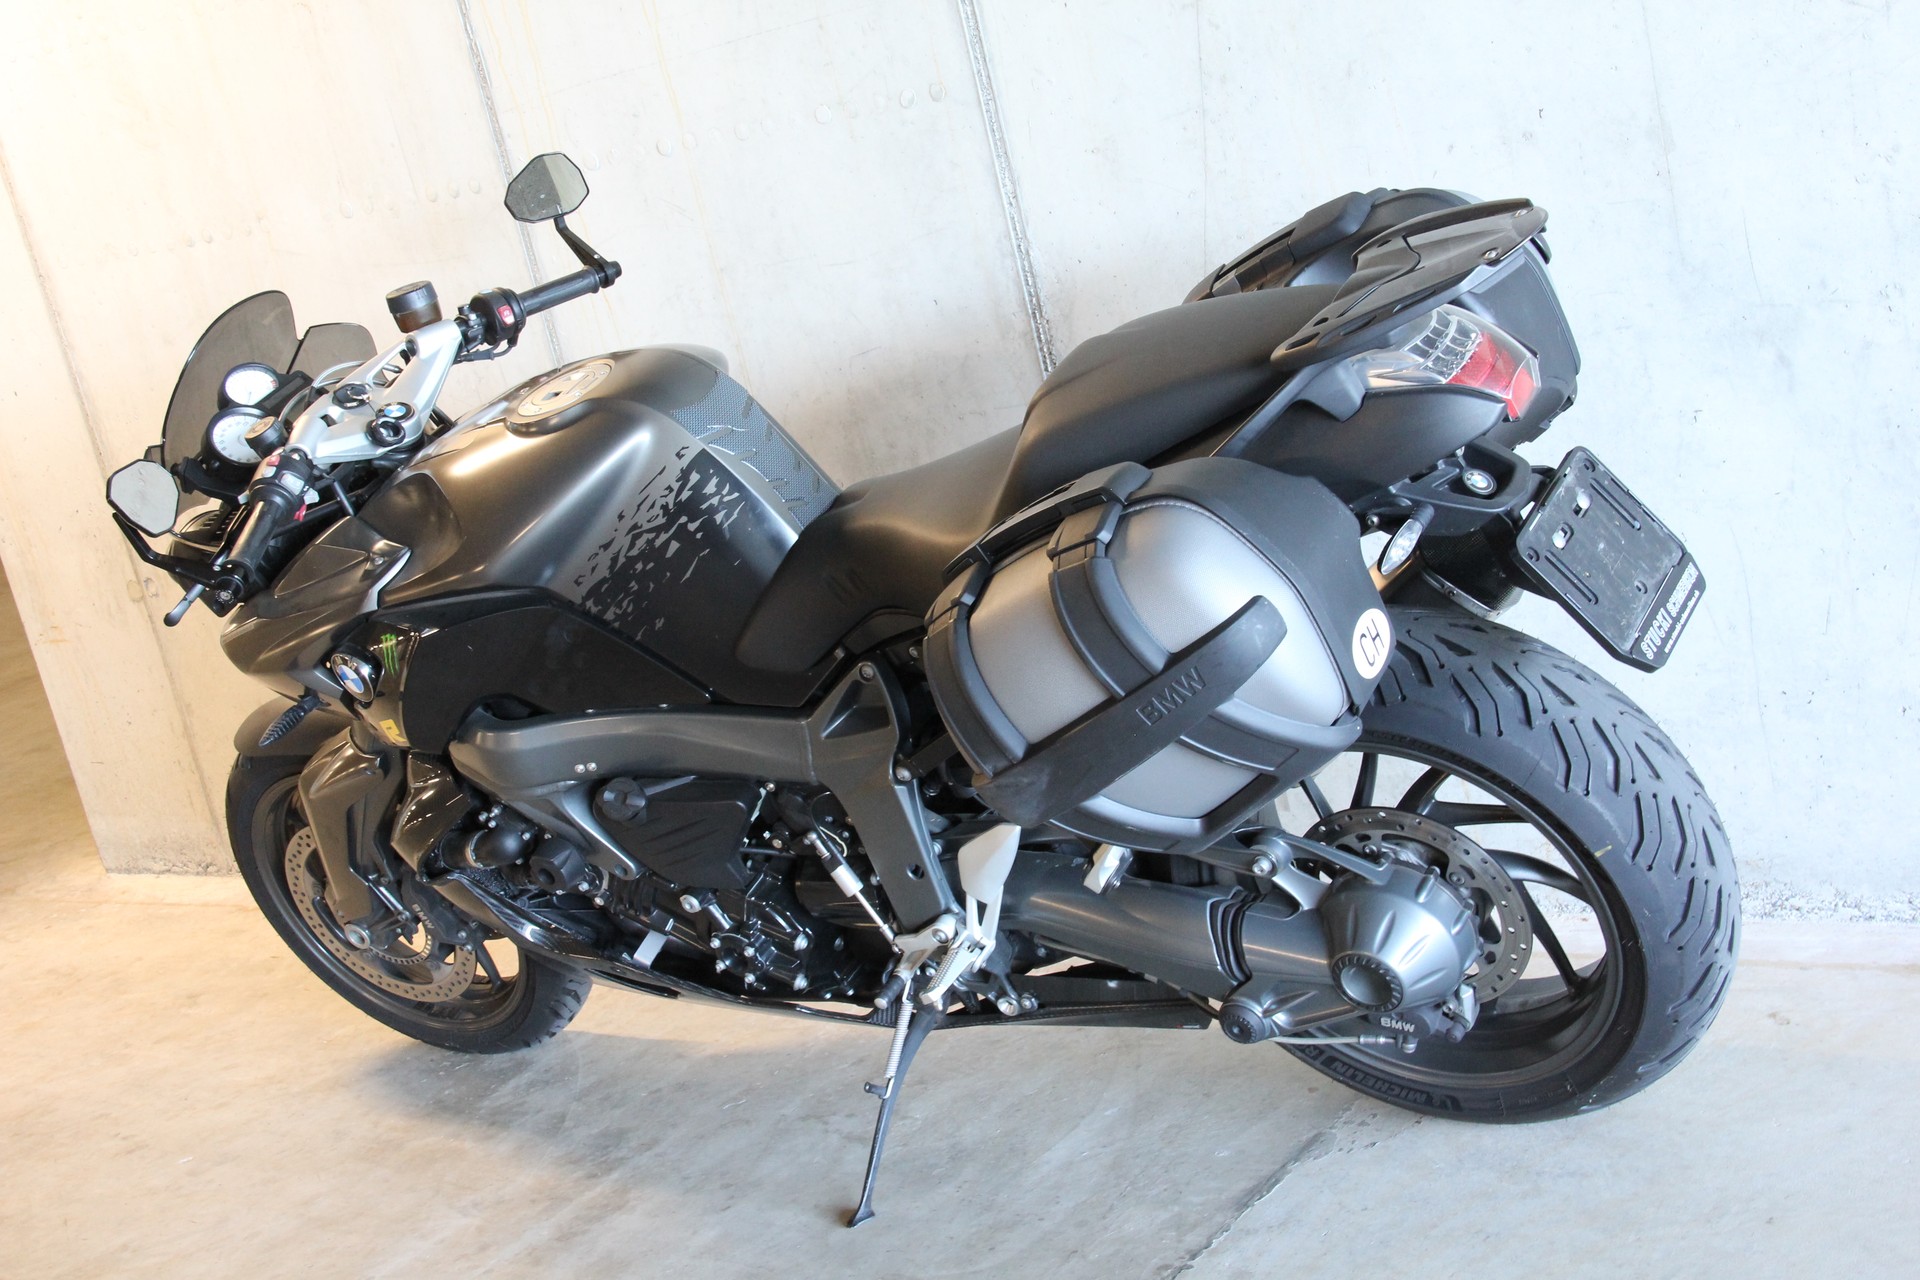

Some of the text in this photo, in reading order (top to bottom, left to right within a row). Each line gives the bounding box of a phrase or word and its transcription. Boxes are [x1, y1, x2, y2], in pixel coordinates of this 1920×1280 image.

[1359, 618, 1385, 668] CH
[1640, 607, 1673, 660] STUCKI
[1135, 665, 1207, 726] BMW
[411, 903, 435, 929] BMW
[1380, 1016, 1416, 1033] BMW
[1329, 1060, 1428, 1104] MICHELIN
